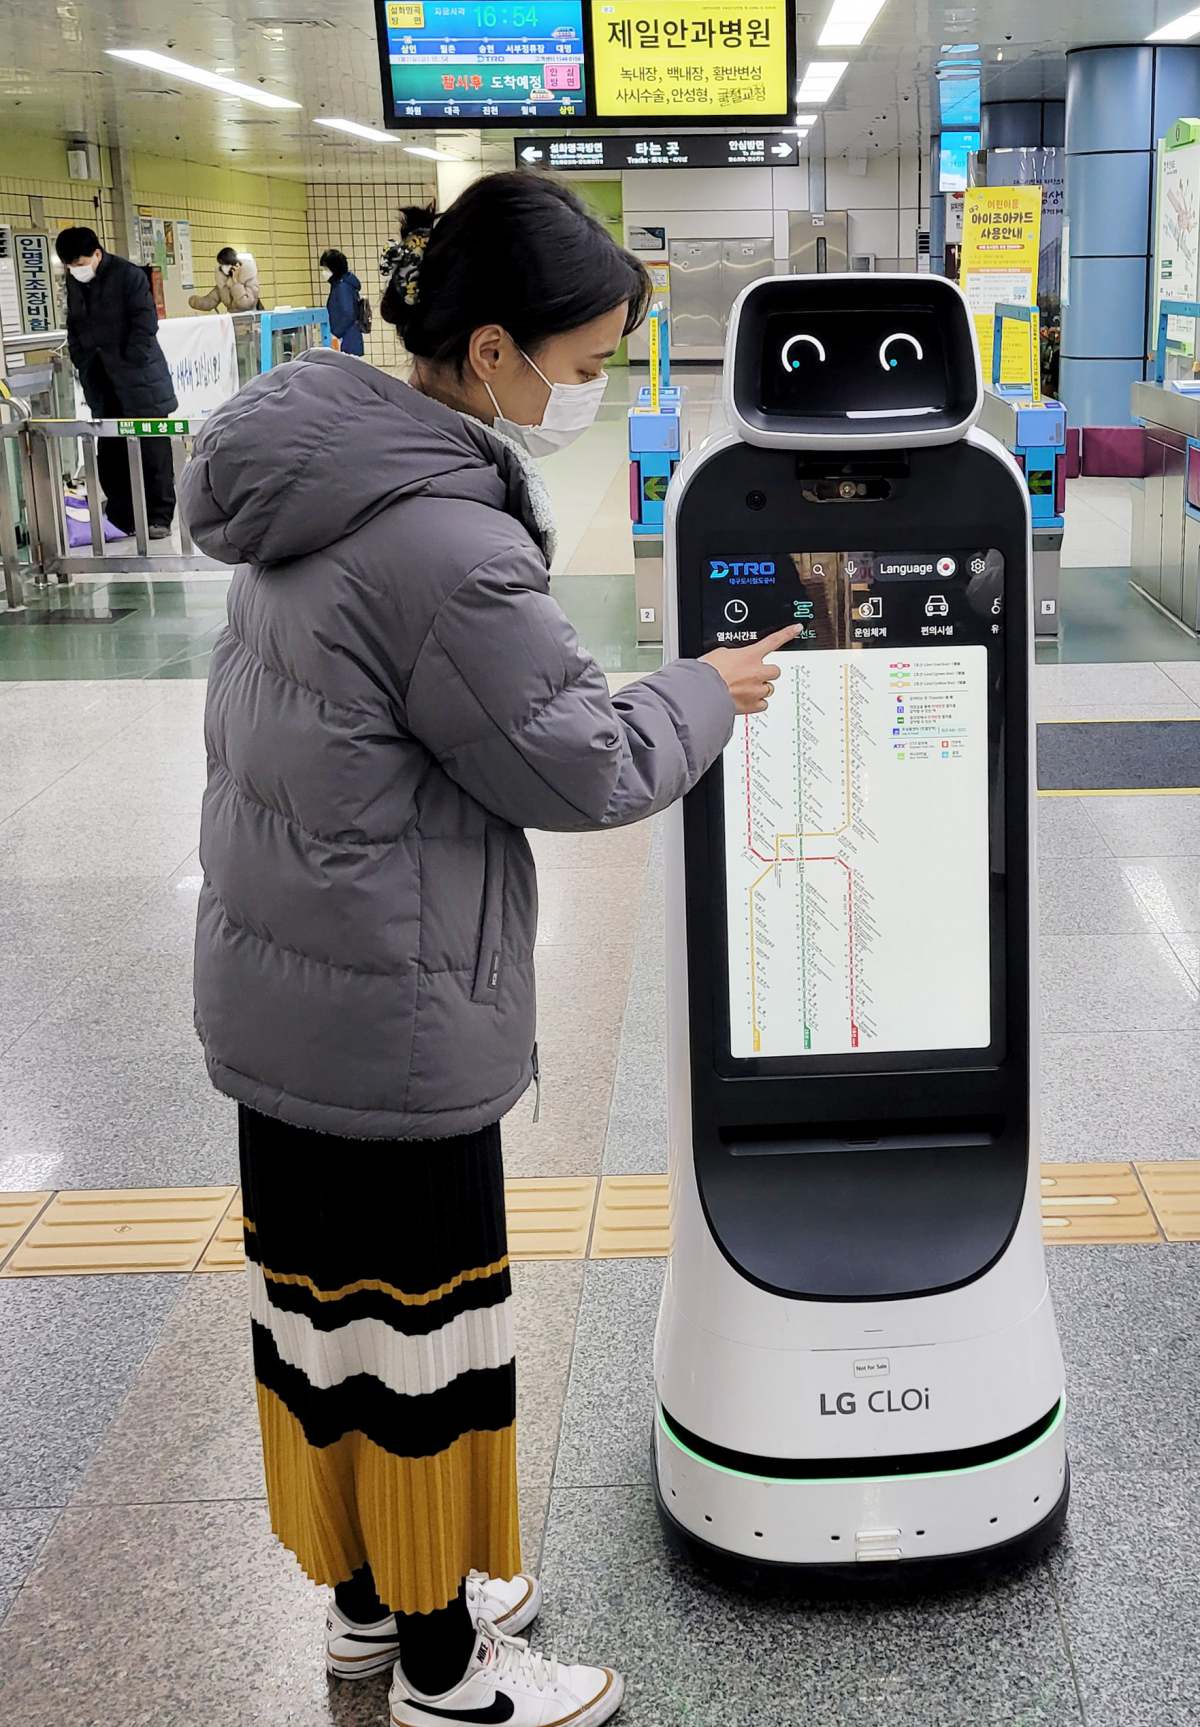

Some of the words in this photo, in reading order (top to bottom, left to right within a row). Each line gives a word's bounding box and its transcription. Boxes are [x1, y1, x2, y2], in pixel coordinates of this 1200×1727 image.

[434, 7, 465, 16] 지금시각
[474, 6, 538, 27] 16:54
[607, 18, 770, 49] 제일안과병원
[401, 44, 417, 54] 상인
[506, 44, 545, 54] 서부정류장
[556, 44, 572, 54] 대명
[620, 66, 662, 83] 녹내장,
[667, 66, 708, 83] 백내장,
[713, 66, 762, 81] 황반변성
[490, 75, 541, 90] 도착예정
[444, 106, 460, 116] 대곡
[482, 106, 498, 116] 진천
[559, 106, 575, 115] 상인
[635, 142, 661, 156] 타는
[666, 142, 680, 156] 곳
[728, 140, 764, 150] 안심방면
[969, 205, 979, 213] 대구
[988, 200, 1019, 209] 어린이용
[972, 212, 1033, 225] 아이조아카드
[981, 227, 1022, 240] 사용안내
[20, 238, 51, 331] 인명구조장비함
[710, 561, 775, 579] DTRO
[880, 563, 933, 576] Language
[729, 577, 775, 585] 대구도시철도공사
[716, 631, 758, 641] 열차시간표
[854, 627, 887, 638] 운임체계
[921, 626, 954, 636] 편의시설
[820, 1392, 856, 1415] LG
[868, 1387, 929, 1412] CLOi
[476, 1642, 488, 1663] NIKE
